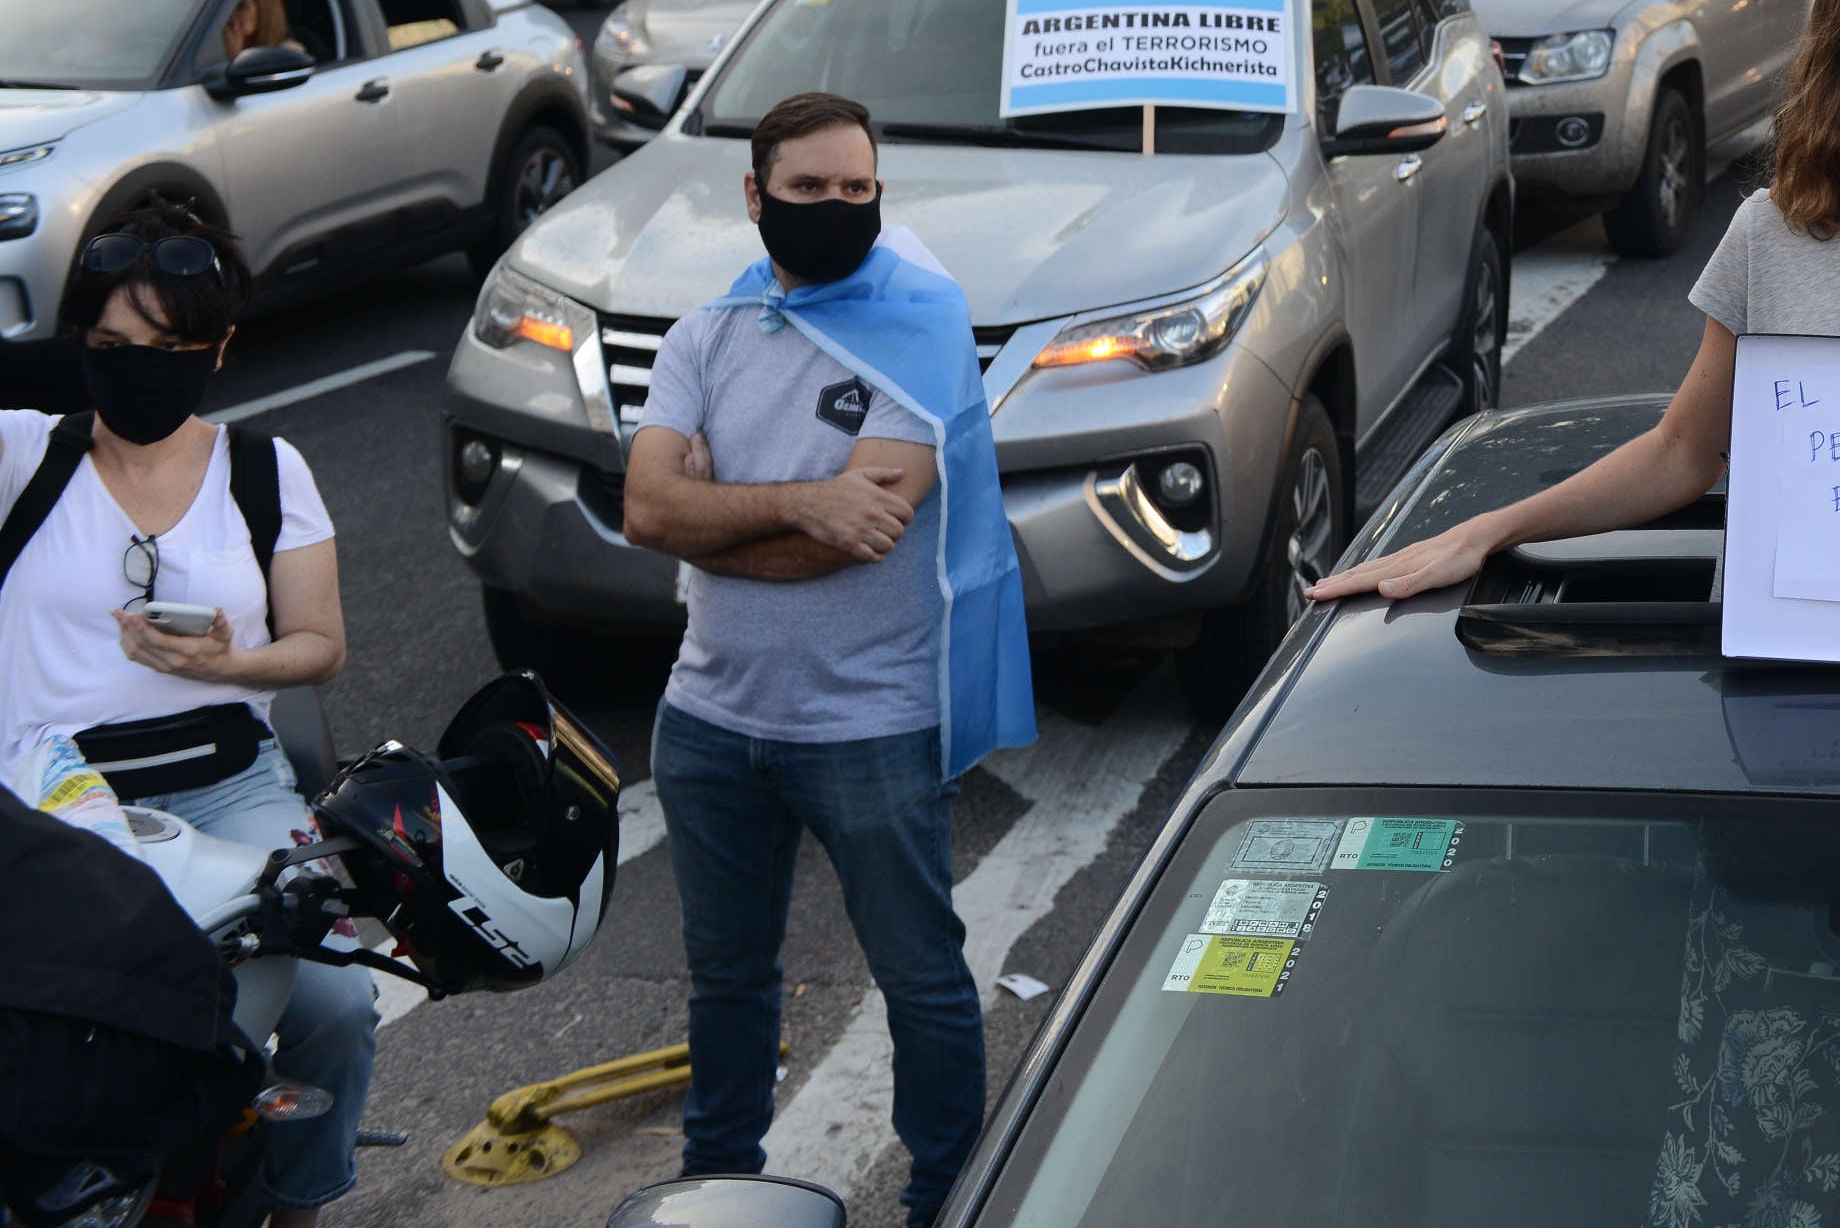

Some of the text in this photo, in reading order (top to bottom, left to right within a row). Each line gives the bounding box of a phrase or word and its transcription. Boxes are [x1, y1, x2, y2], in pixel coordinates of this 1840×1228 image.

[1022, 11, 1281, 35] ARGENTINA LIBRE
[1034, 36, 1268, 57] fuera el TERRORISMO
[1020, 56, 1278, 78] CastroChavistaKichnerista
[1773, 379, 1819, 411] EL
[1339, 852, 1359, 860] RTO
[1171, 974, 1190, 982] RTO
